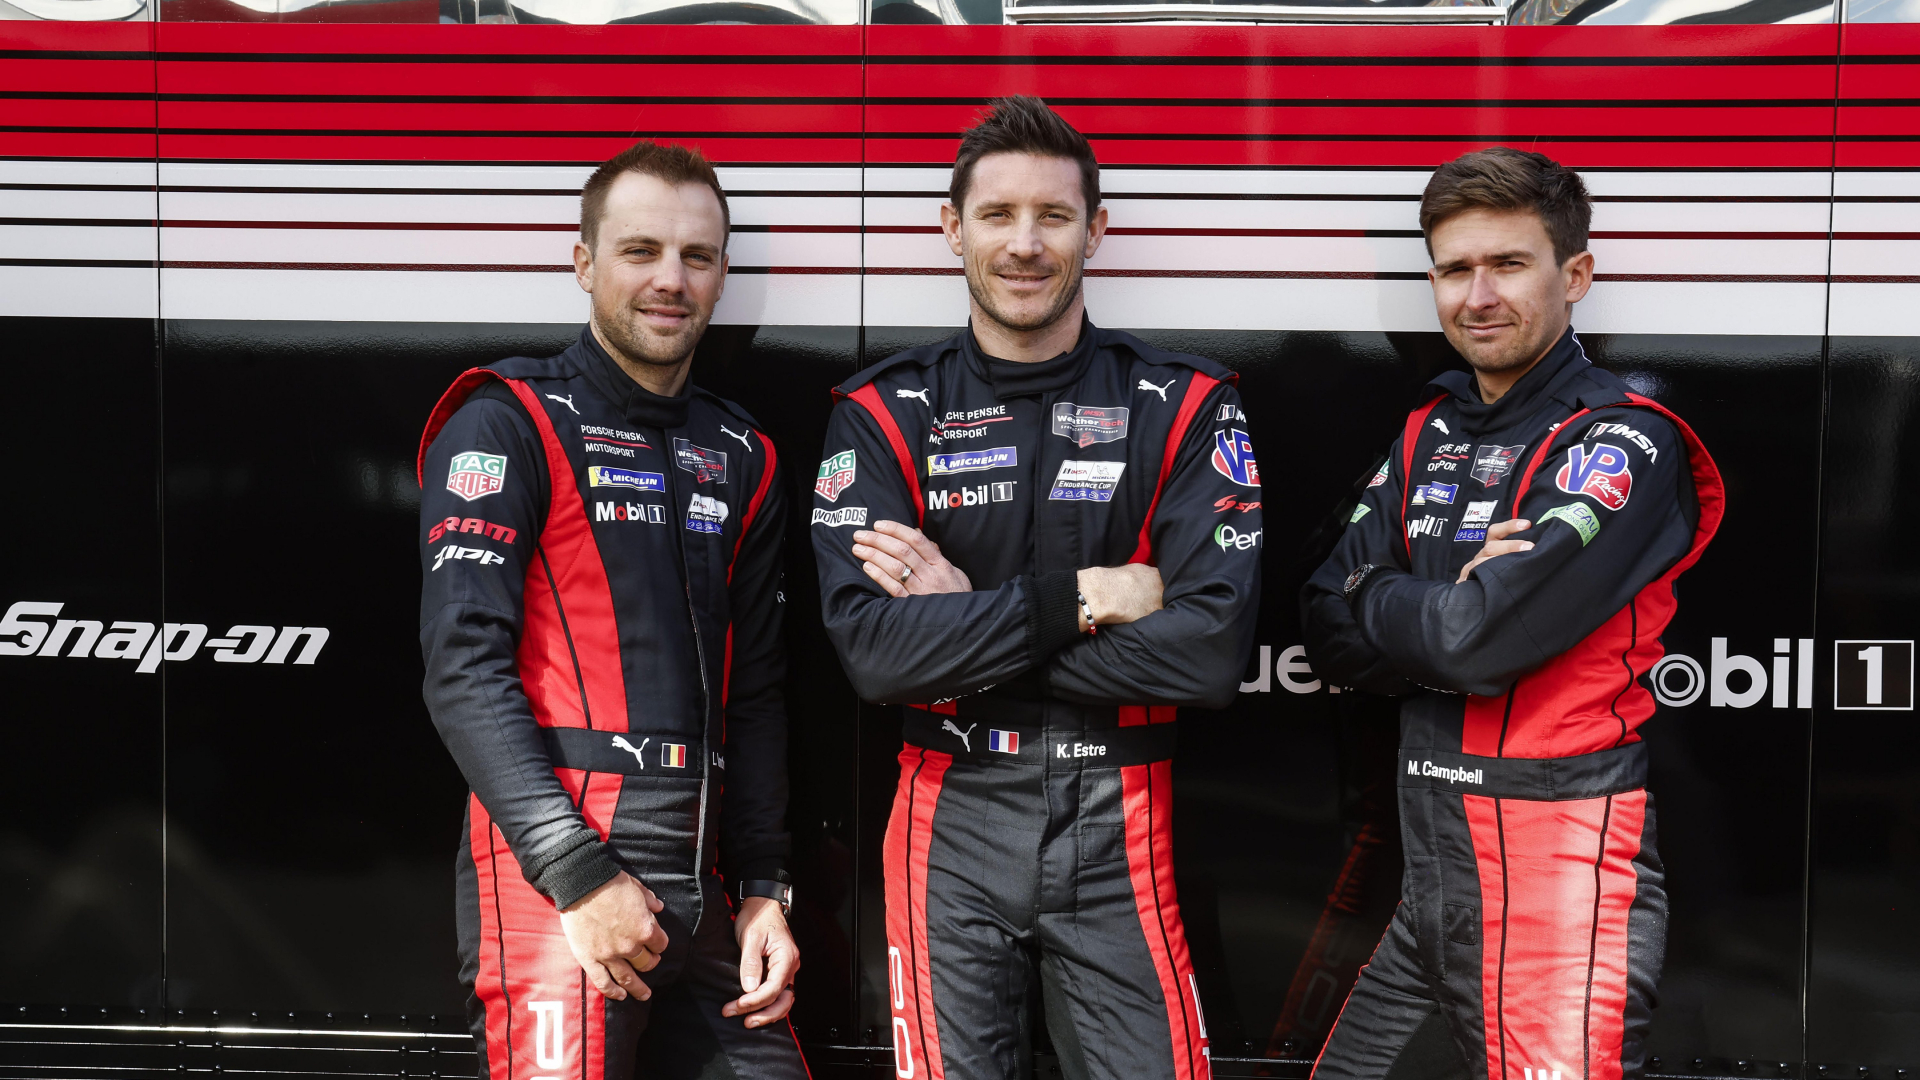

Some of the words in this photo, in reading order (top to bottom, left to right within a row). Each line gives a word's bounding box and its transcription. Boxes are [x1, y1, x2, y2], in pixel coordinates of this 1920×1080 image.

[967, 405, 1006, 420] PENSKE
[580, 424, 615, 438] PORSCHE
[585, 442, 635, 458] MOTORSPORT
[1606, 423, 1659, 464] IMSA
[454, 455, 500, 475] TAG
[821, 454, 852, 476] TAG
[949, 453, 1008, 468] MICHELIN
[1567, 443, 1629, 493] VP
[448, 473, 499, 498] HEUER
[612, 474, 658, 486] MICHELIN
[815, 471, 852, 498] HEUER
[1587, 475, 1627, 505] Racing
[928, 484, 988, 511] Mobil
[595, 501, 647, 522] Mobil
[814, 508, 843, 524] WONG
[844, 508, 867, 523] DDS
[427, 516, 518, 545] SRAM
[0, 601, 330, 674] Snap-on
[1056, 744, 1070, 758] K.
[1074, 743, 1107, 757] Estre
[1407, 760, 1420, 776] M.
[1422, 761, 1483, 784] Campbell
